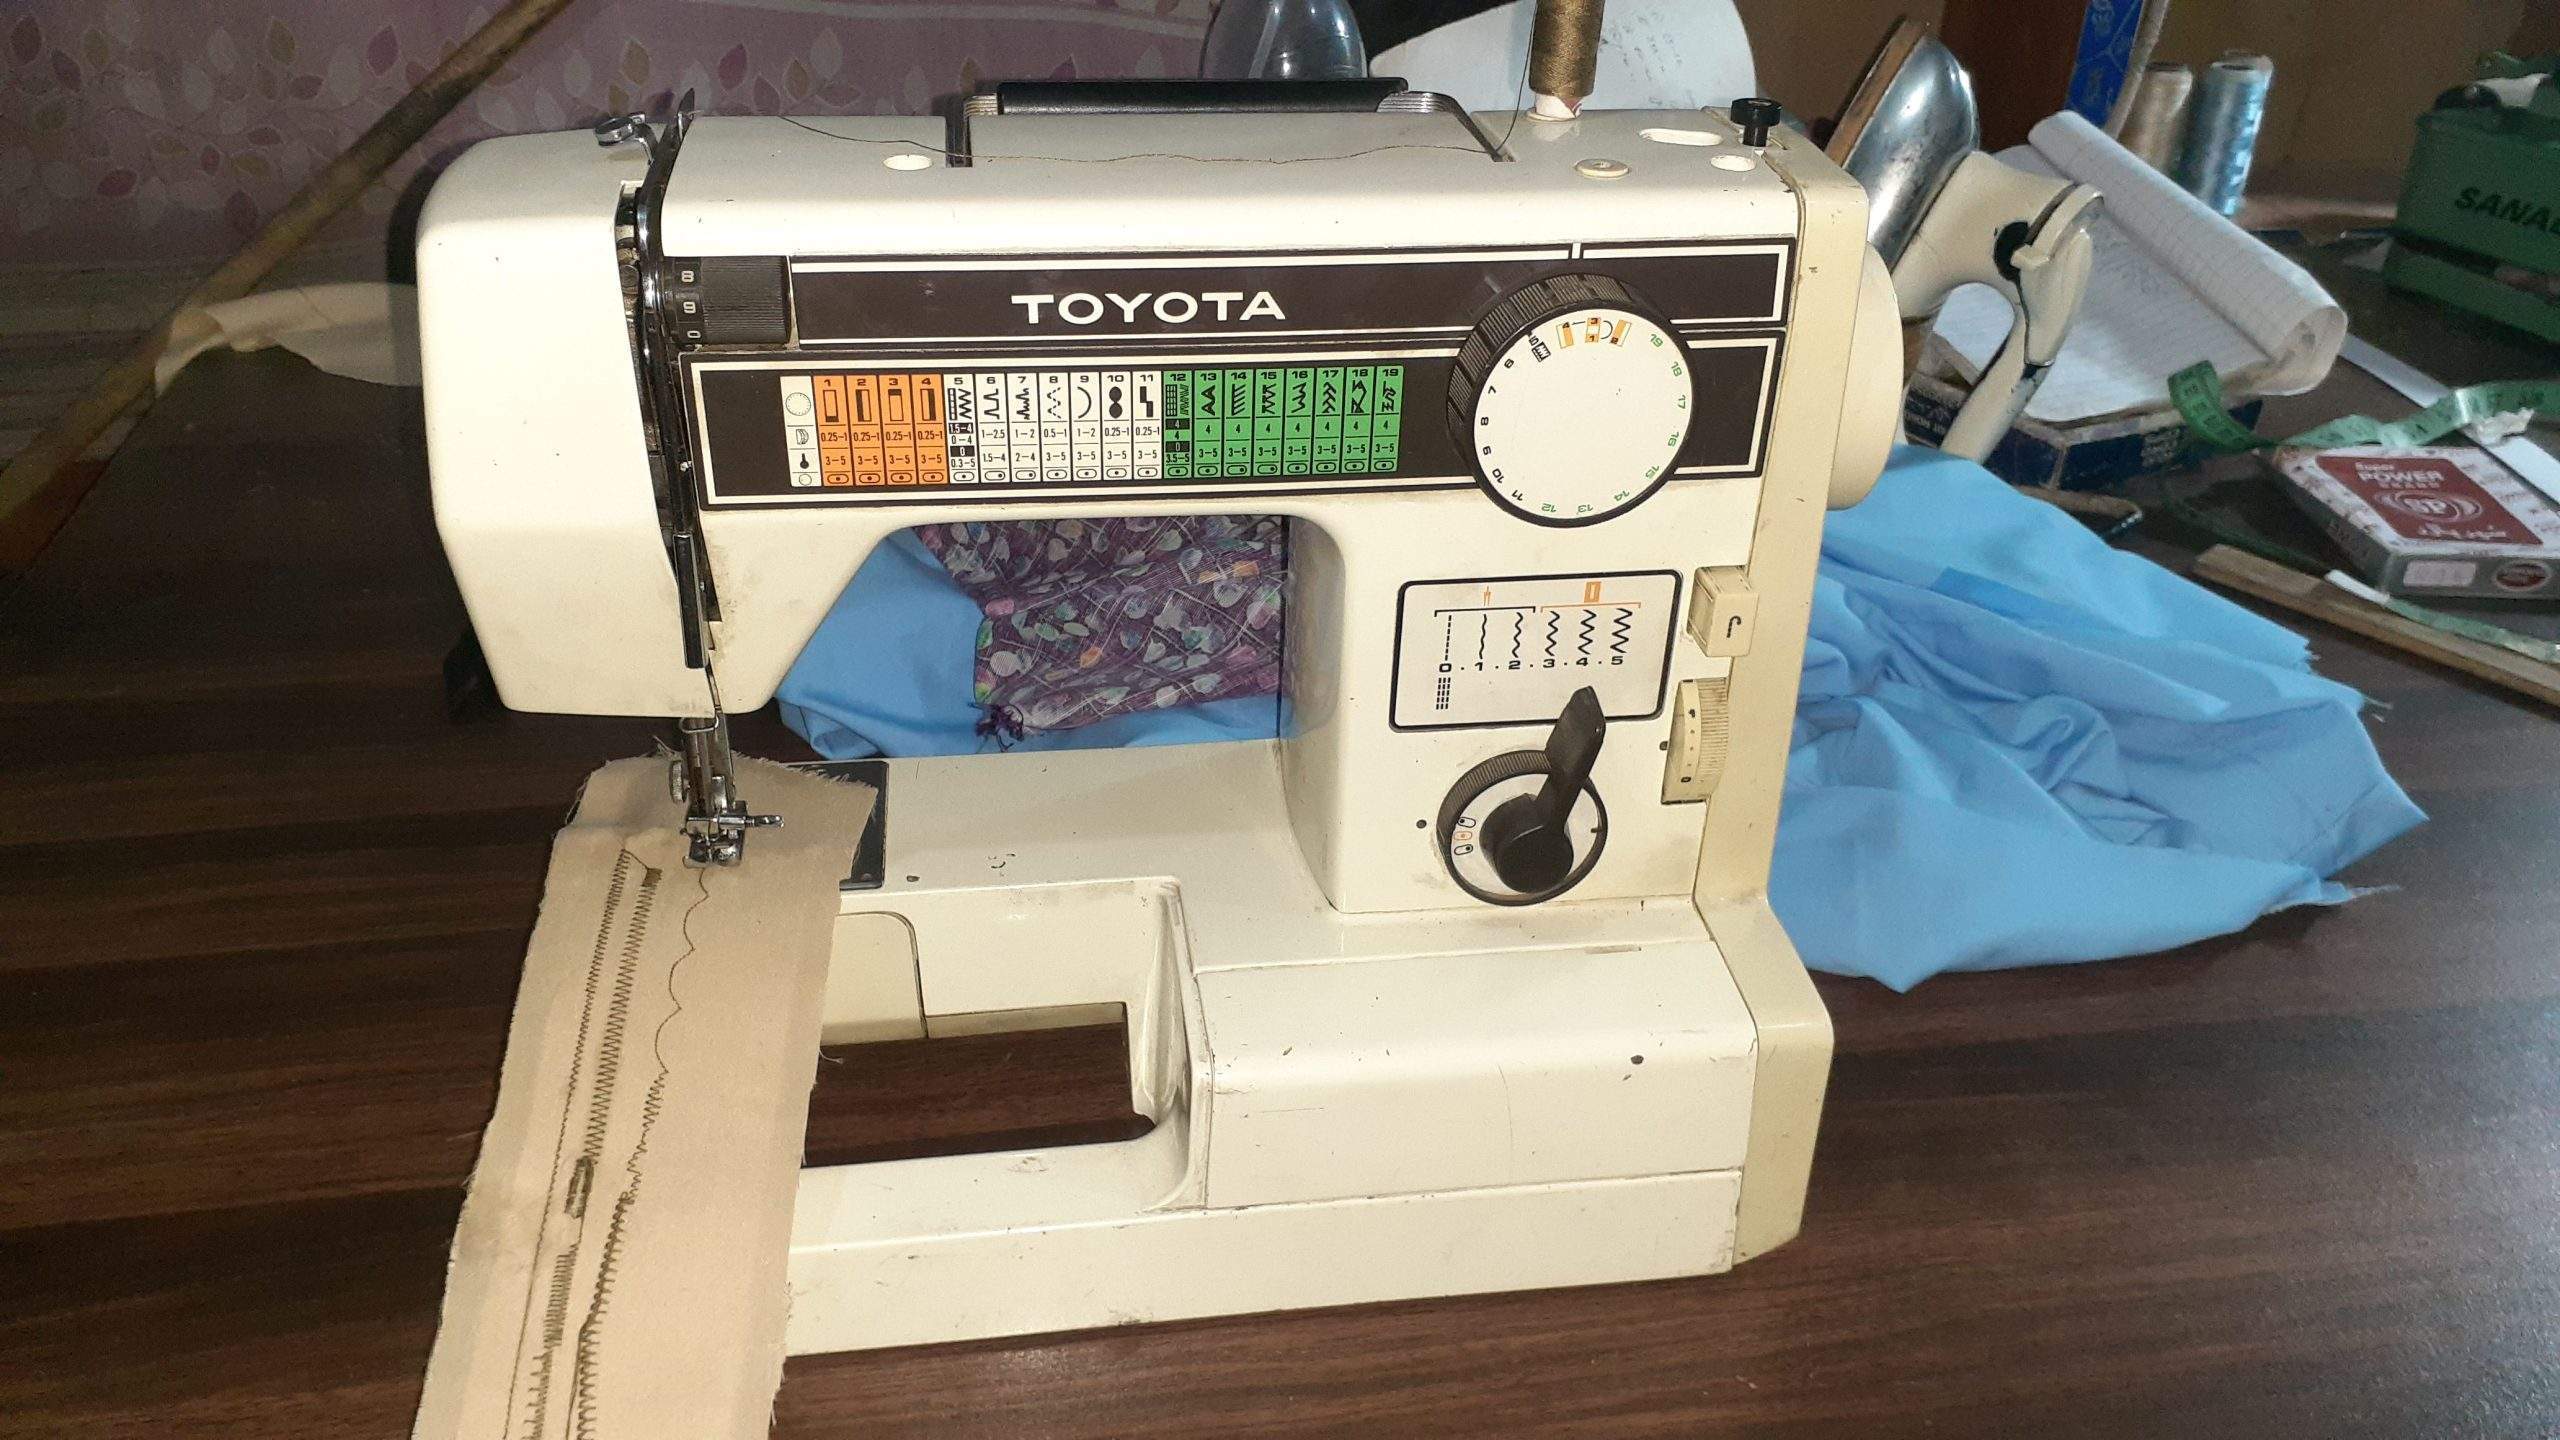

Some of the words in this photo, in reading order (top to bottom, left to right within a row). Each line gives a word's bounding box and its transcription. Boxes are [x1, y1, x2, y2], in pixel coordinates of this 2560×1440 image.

[1011, 291, 1286, 325] TOYOTA
[1529, 335, 1539, 346] 5
[1650, 333, 1663, 348] 19
[1671, 361, 1683, 377] 18
[824, 379, 831, 387] 1
[857, 378, 867, 386] 2
[921, 377, 932, 385] 4
[953, 377, 964, 385] 5
[986, 376, 996, 384] 6
[1017, 376, 1027, 384] 7
[1049, 376, 1059, 384] 8
[1080, 375, 1089, 383] 9
[1107, 375, 1124, 383] 10
[1140, 374, 1154, 382] 11
[1170, 373, 1186, 382] 12
[1200, 372, 1217, 381] 13
[1230, 371, 1247, 380] 14
[1260, 371, 1277, 380] 15
[1292, 370, 1309, 379] 16
[1322, 369, 1339, 378] 17
[1352, 368, 1369, 377] 18
[1382, 368, 1399, 377] 19
[1488, 385, 1497, 395] 7
[1677, 394, 1686, 409] 17
[1174, 420, 1180, 429] 4
[1205, 424, 1211, 434] 4
[1235, 423, 1241, 434] 4
[1265, 423, 1271, 433] 4
[1295, 422, 1301, 433] 4
[1324, 421, 1330, 431] 4
[1353, 421, 1359, 431] 4
[1383, 420, 1389, 430] 4
[1480, 416, 1489, 426] 8
[1174, 431, 1180, 440] 4
[1667, 431, 1680, 447] 16
[960, 447, 965, 456] 0
[1175, 442, 1181, 451] 0
[1482, 445, 1492, 455] 9
[1492, 468, 1505, 484] 10
[1645, 465, 1660, 479] 15
[2357, 470, 2445, 482] POWER
[1512, 489, 1525, 501] 11
[1614, 490, 1630, 502] 14
[1541, 503, 1557, 513] 12
[1577, 504, 1594, 514] 13
[1439, 662, 1452, 673] 0
[1474, 662, 1484, 672] 1
[1508, 660, 1521, 670] 2
[1542, 658, 1555, 668] 3
[1576, 657, 1589, 667] 4
[1610, 656, 1624, 666] 5
